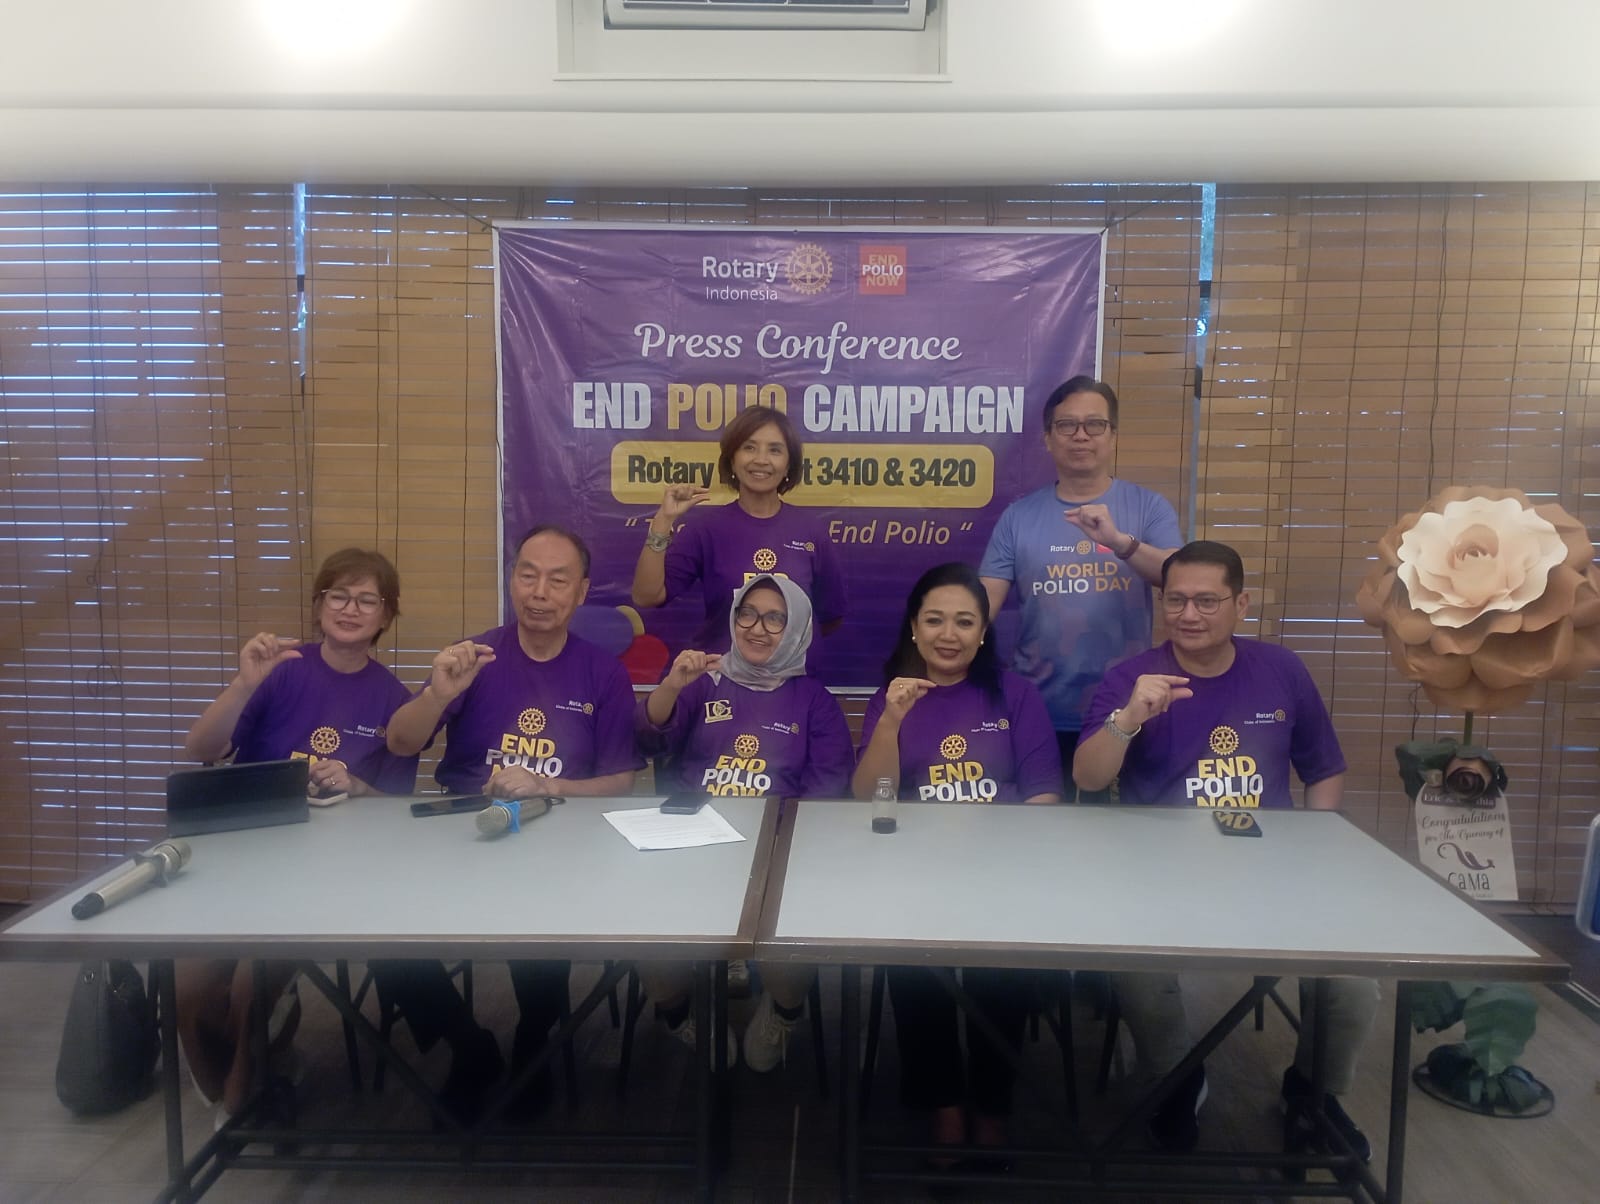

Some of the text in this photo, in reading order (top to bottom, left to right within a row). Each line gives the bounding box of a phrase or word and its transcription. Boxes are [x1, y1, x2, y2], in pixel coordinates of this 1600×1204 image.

[702, 256, 779, 282] Rotary
[862, 264, 904, 276] POLIO
[868, 254, 898, 266] END
[866, 274, 900, 287] NOW
[706, 286, 778, 300] Indonesia
[633, 321, 962, 374] Press Conference
[573, 382, 652, 430] END
[803, 383, 1024, 433] CAMPAIGN
[628, 455, 715, 488] Rotary
[816, 457, 879, 486] 3410
[882, 457, 904, 487] &
[909, 458, 976, 487] 3420
[828, 520, 877, 544] End
[883, 520, 950, 545] Polio
[1050, 545, 1075, 553] Rotary
[1046, 561, 1118, 579] WORLD
[1032, 577, 1132, 596] POLIO DAY
[501, 733, 556, 759] END
[485, 748, 563, 778] POLIO
[715, 754, 767, 774] END
[928, 761, 984, 786] END
[1198, 755, 1257, 779] END
[701, 767, 772, 791] POLIO
[918, 778, 998, 802] POLIO
[1185, 774, 1264, 799] POLIO
